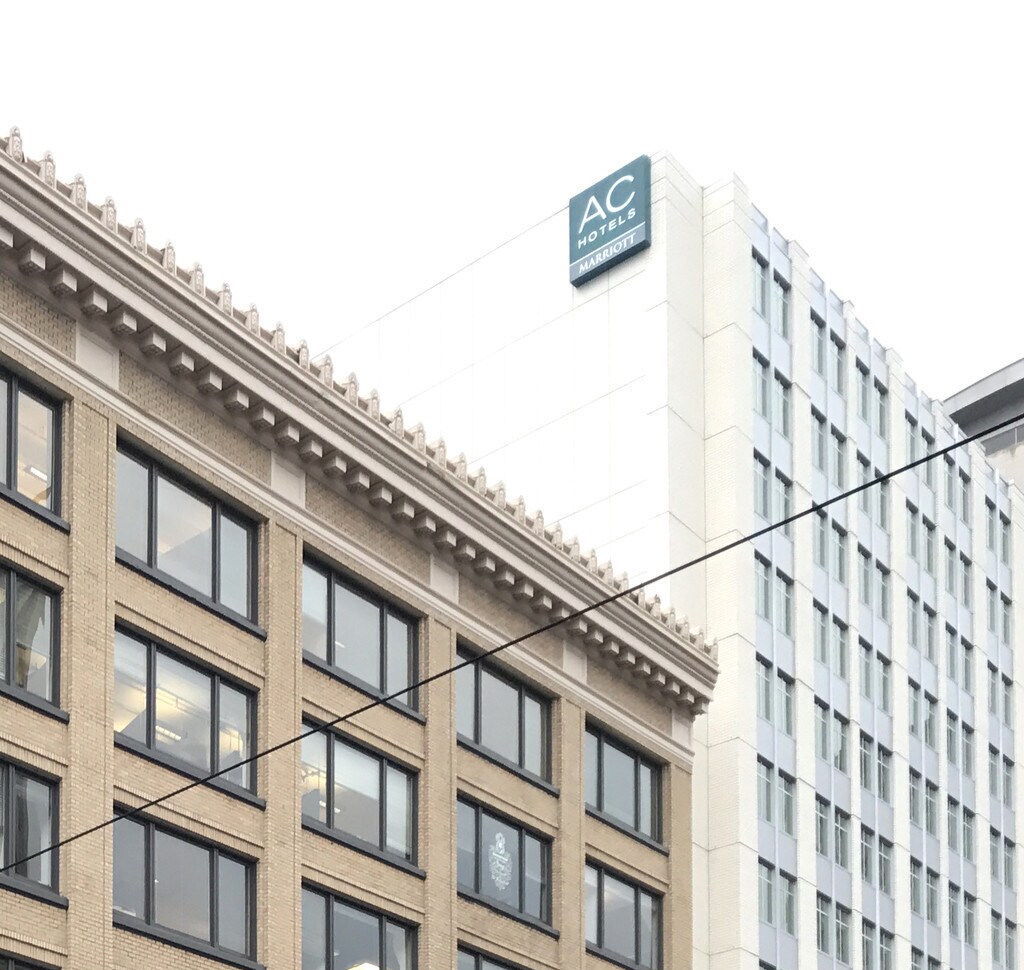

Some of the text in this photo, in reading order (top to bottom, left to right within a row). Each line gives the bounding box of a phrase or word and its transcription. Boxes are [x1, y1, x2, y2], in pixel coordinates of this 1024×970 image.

[578, 175, 635, 234] AC
[578, 208, 636, 249] HOTELS
[579, 233, 636, 274] MARRIOTT
